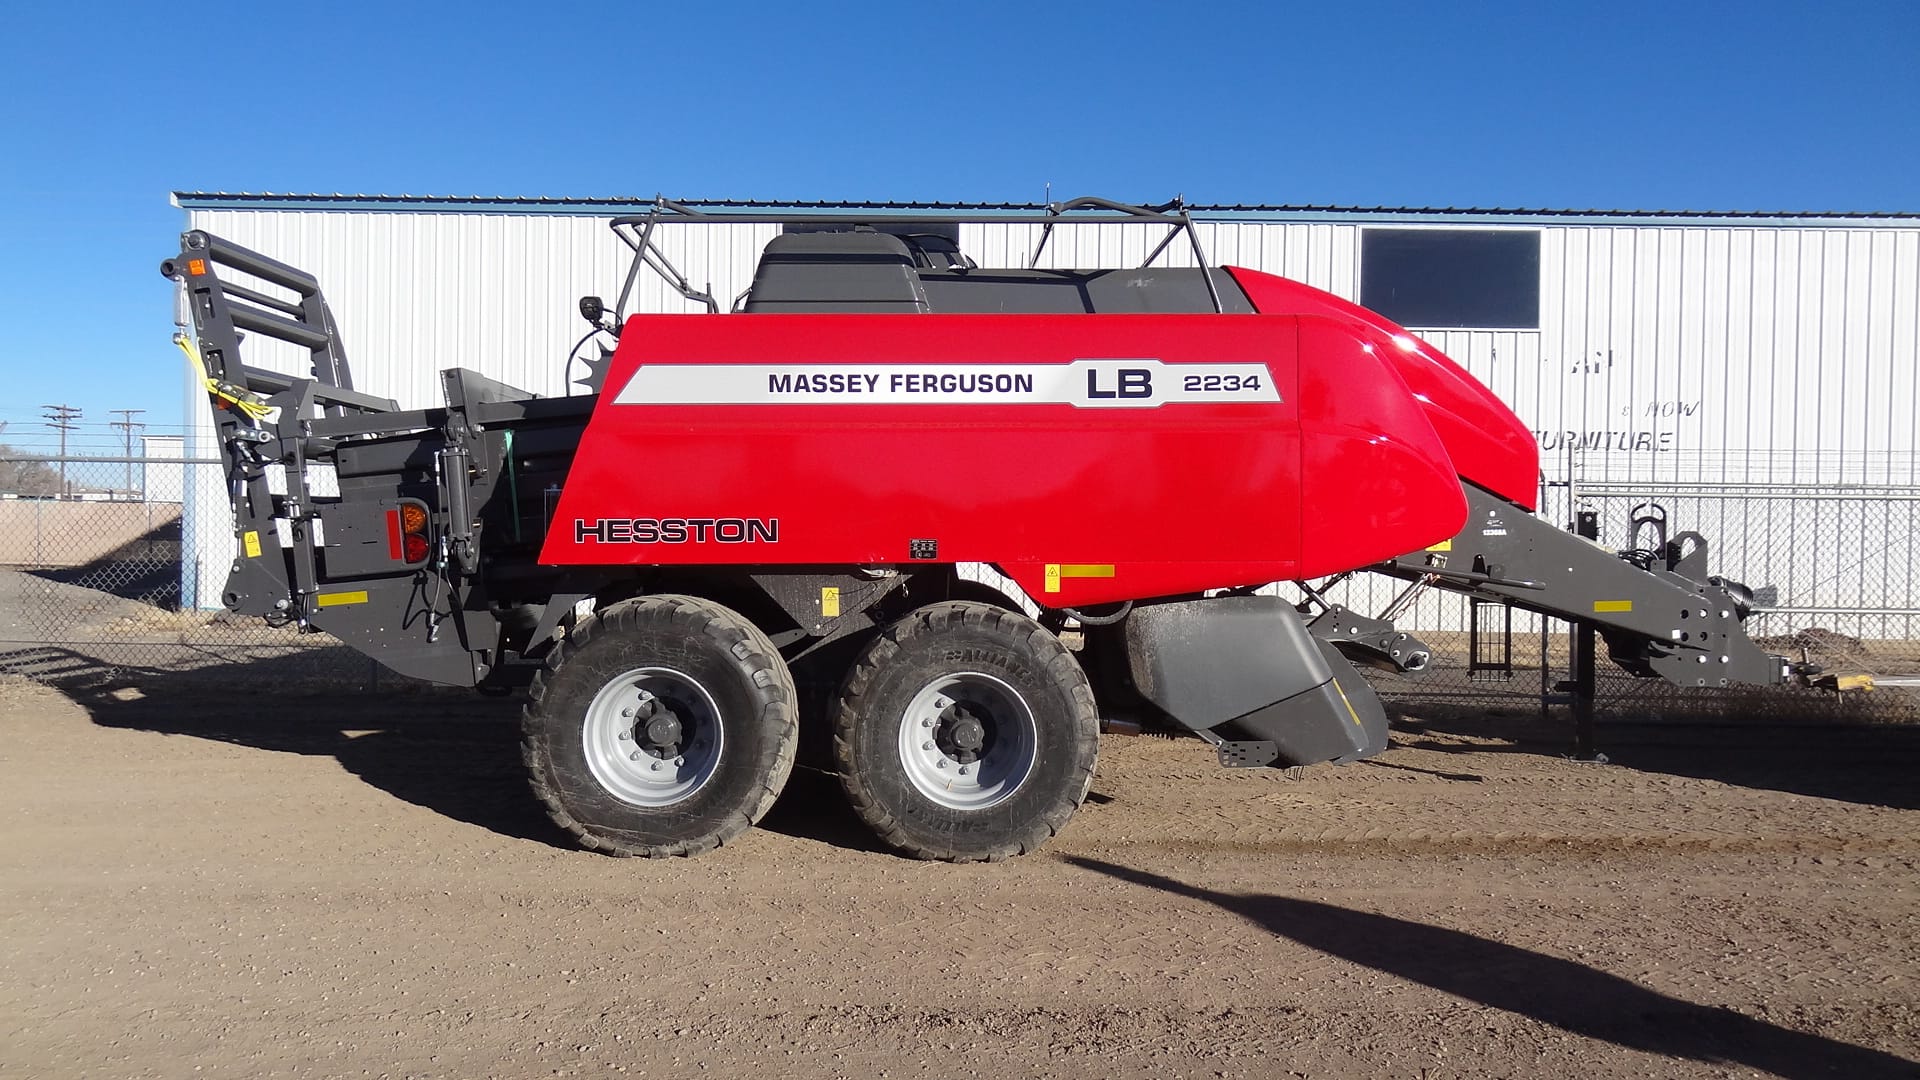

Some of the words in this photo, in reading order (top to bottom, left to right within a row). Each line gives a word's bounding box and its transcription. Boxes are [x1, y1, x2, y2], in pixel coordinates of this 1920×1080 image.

[768, 374, 880, 393] MASSEY
[890, 374, 1033, 393] FERGUSON
[1087, 368, 1153, 399] LB
[1183, 375, 1261, 392] 2234
[574, 518, 779, 543] HESSTON
